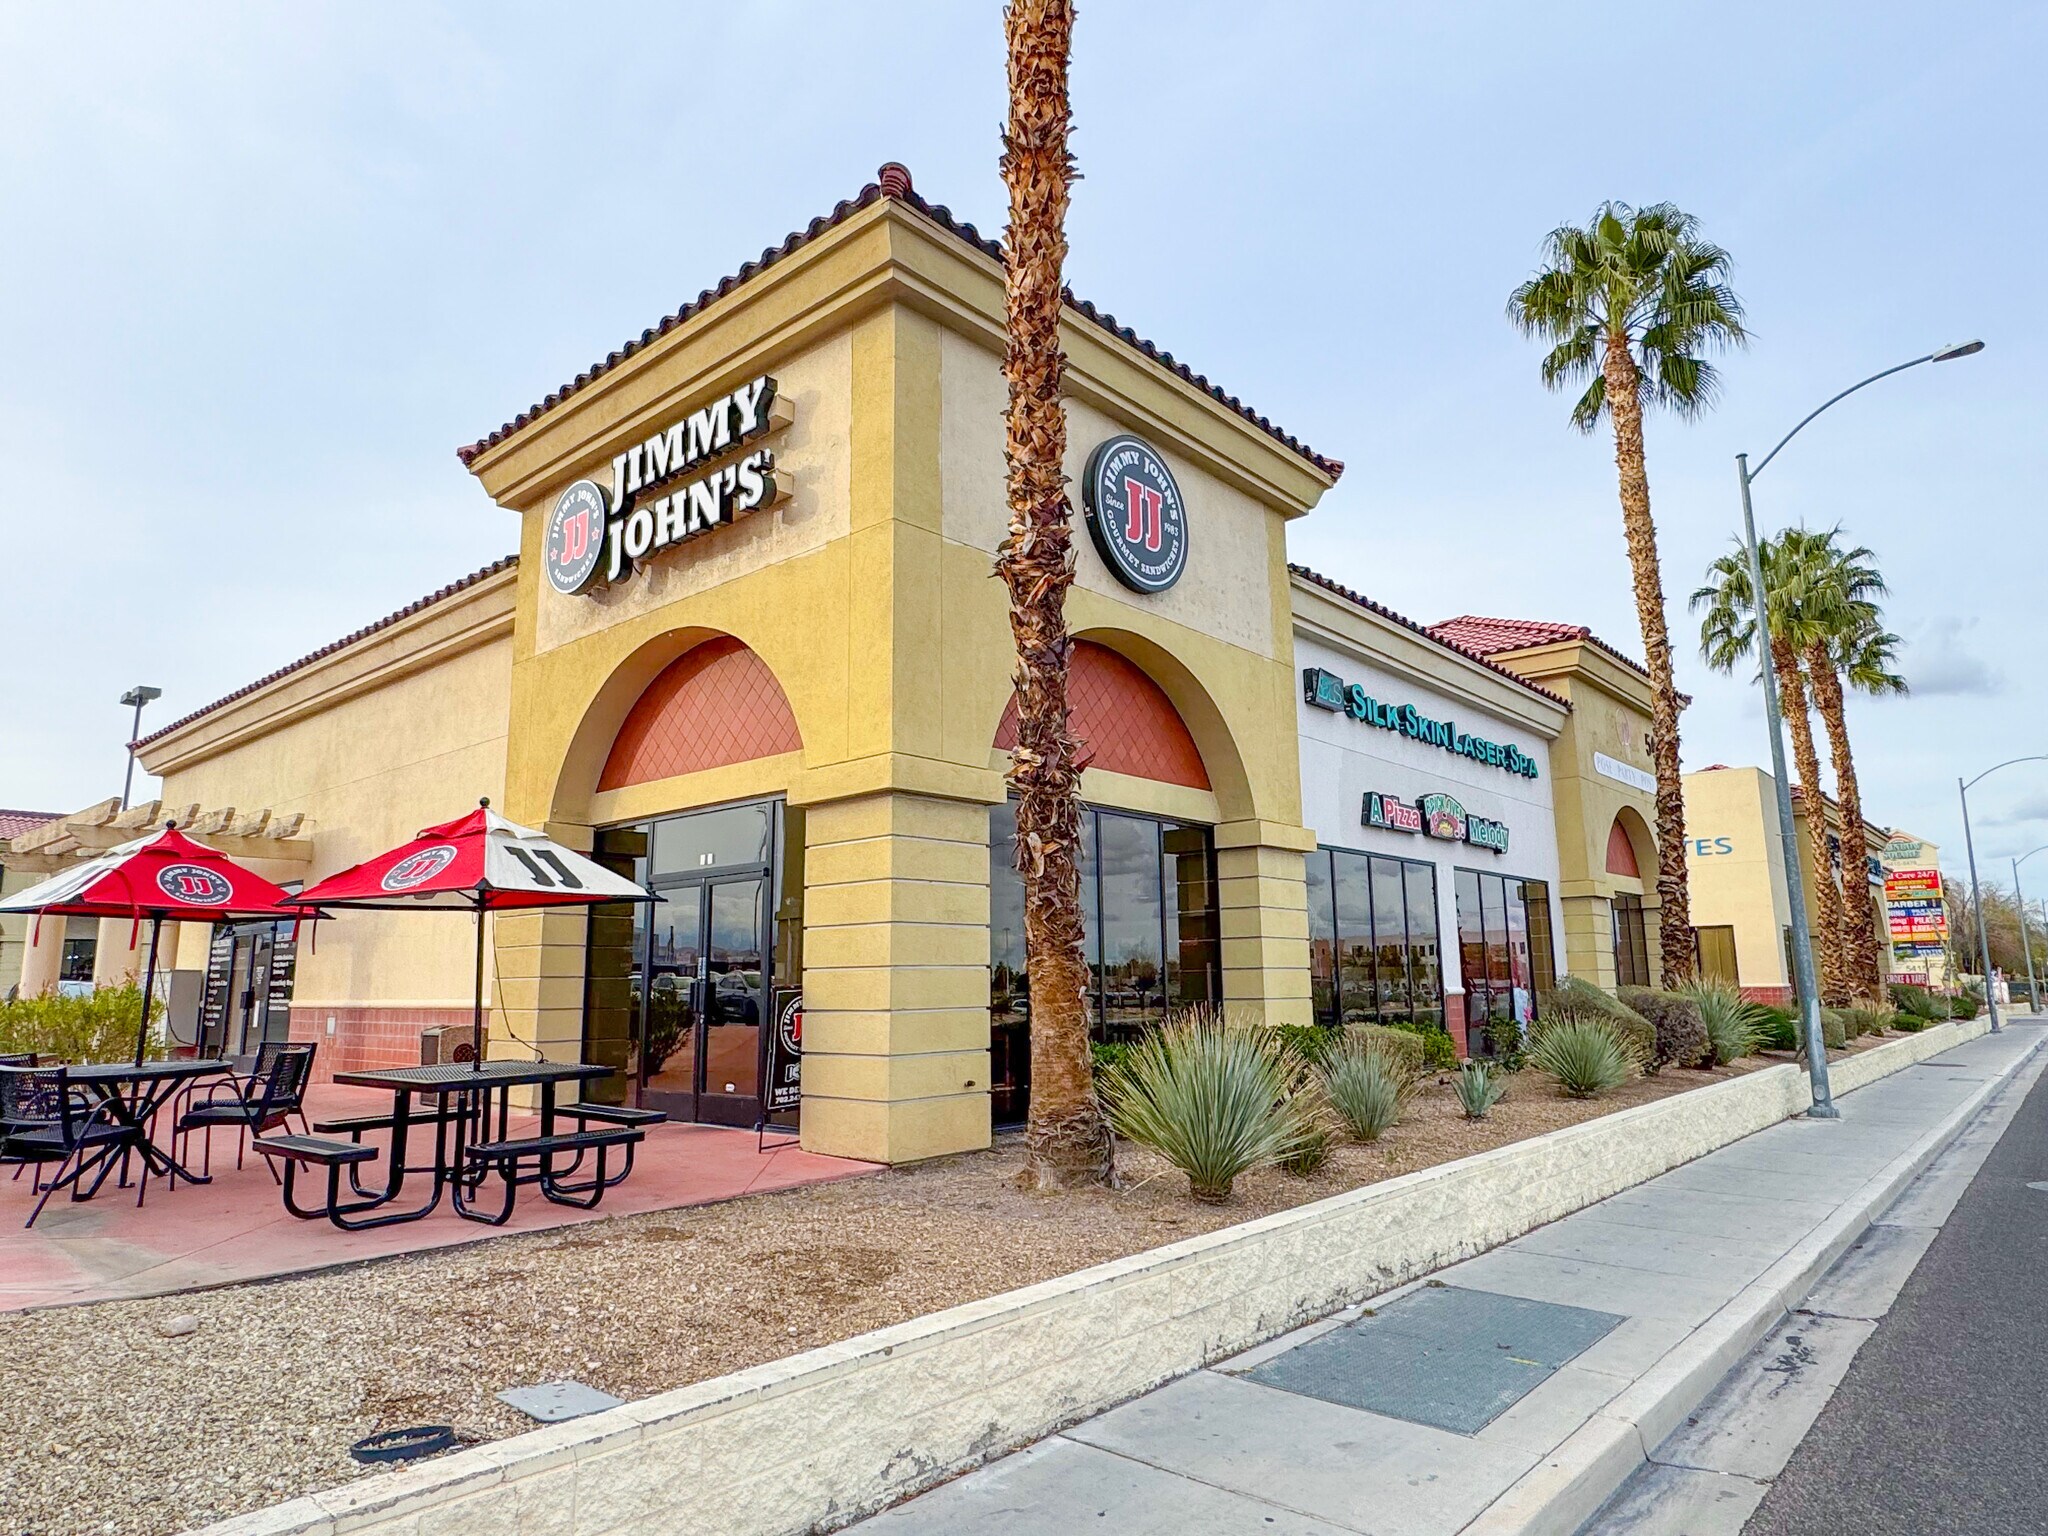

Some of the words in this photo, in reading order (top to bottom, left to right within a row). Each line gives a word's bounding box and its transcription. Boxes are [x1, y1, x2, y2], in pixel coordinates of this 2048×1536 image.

[610, 375, 769, 515] JIMMY
[552, 493, 576, 539] JIMMY
[577, 490, 599, 519] JOHN'S
[1104, 451, 1140, 493] JIMMY
[1143, 457, 1178, 521] JOHN'S
[1124, 476, 1163, 552] JJ
[561, 509, 589, 566] JJ
[608, 452, 767, 582] JOHN'S
[1107, 510, 1139, 568] GOURMET
[1141, 540, 1179, 576] SANDWICHES
[555, 553, 593, 584] SANDWICHES
[1352, 684, 1400, 731] SILK
[1406, 704, 1449, 747] SKIN
[1451, 721, 1506, 768] LASER
[1509, 744, 1538, 778] SPA
[1371, 796, 1383, 821] A
[1384, 799, 1420, 829] Pizza
[1470, 816, 1508, 852] Melody
[178, 876, 213, 895] JJ
[398, 859, 441, 879] JJ
[792, 1013, 802, 1040] J
